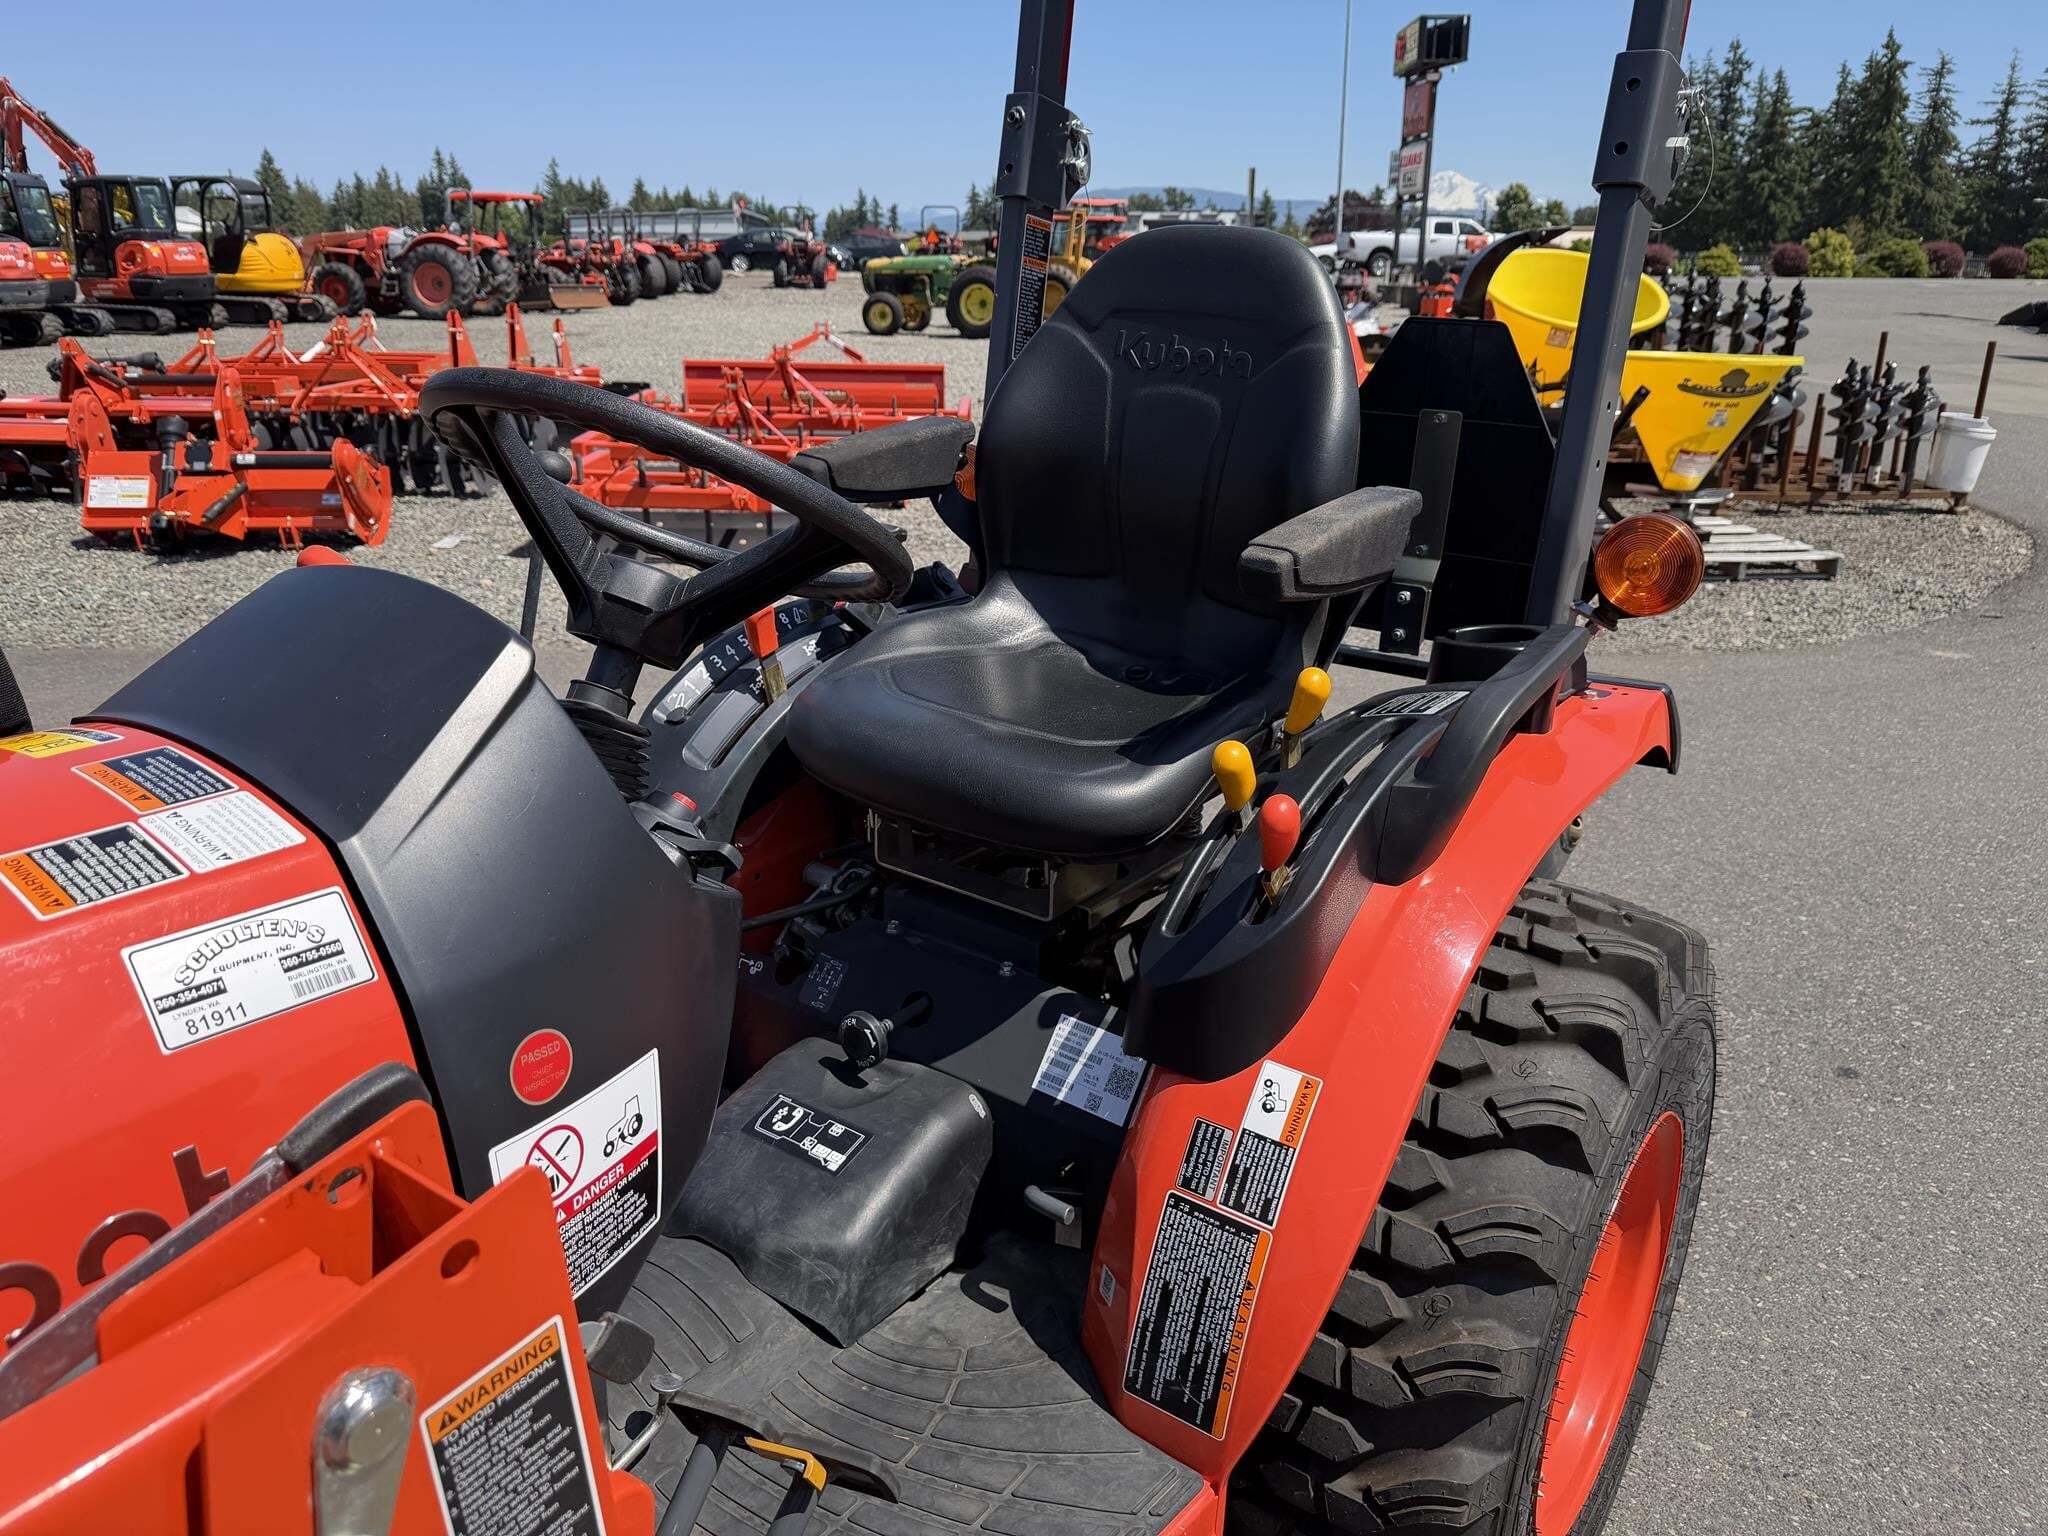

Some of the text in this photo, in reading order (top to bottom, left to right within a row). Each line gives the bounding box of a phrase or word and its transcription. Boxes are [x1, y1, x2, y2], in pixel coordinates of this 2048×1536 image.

[1117, 329, 1255, 379] Kubota
[778, 612, 789, 624] 8
[710, 655, 722, 667] 3
[725, 645, 736, 656] 4
[737, 634, 749, 646] 5
[174, 819, 221, 852] WARNING
[3, 857, 55, 901] WARNING
[176, 919, 326, 986] SCHOLTEN'S
[154, 979, 225, 1011] 360-354-4071
[183, 1001, 248, 1036] 81911
[520, 1040, 561, 1066] PASSED
[531, 1063, 554, 1080] CHIEF
[523, 1069, 566, 1094] INSPECTOR
[1194, 1122, 1206, 1146] stopped
[1214, 1128, 1221, 1138] Do
[1284, 1090, 1310, 1144] WARNING
[1210, 1137, 1218, 1148] not
[574, 1162, 623, 1209] DANGER
[1190, 1177, 1198, 1189] has
[1193, 1163, 1202, 1178] PTO
[1202, 1161, 1211, 1175] PTO
[1208, 1138, 1228, 1191] IMPORTANT
[559, 1158, 648, 1234] OSSIBLE INJURY OR DEATH
[560, 1191, 619, 1243] CHINE RUNAWAY.
[582, 1261, 595, 1277] PTO
[1222, 1232, 1257, 1354] TO AVOID PERSONAL INJURY OR DEATH:
[1220, 1296, 1252, 1394] WARNING
[458, 1335, 550, 1415] WARNING
[442, 1355, 554, 1447] TO AVOID PERSONAL
[450, 1433, 486, 1466] Observe
[487, 1412, 512, 1438] safety
[514, 1377, 558, 1417] precautions
[445, 1421, 486, 1458] INJURY
[454, 1419, 531, 1483] Operator's Manual.
[457, 1460, 490, 1491] Operate
[492, 1448, 506, 1464] the
[506, 1428, 532, 1452] loader
[532, 1412, 552, 1431] from
[462, 1441, 488, 1467] loader
[489, 1427, 506, 1445] and
[507, 1407, 532, 1432] tractor
[519, 1436, 545, 1461] others
[546, 1423, 561, 1440] and
[459, 1442, 526, 1500] tractor seat only.
[463, 1484, 498, 1516] livestock
[500, 1466, 521, 1489] away
[523, 1447, 543, 1468] when
[510, 1485, 533, 1507] which
[534, 1470, 552, 1490] may
[552, 1449, 576, 1474] cause
[467, 1509, 491, 1532] Avoid
[517, 1470, 539, 1492] loose
[479, 1488, 505, 1514] loader
[506, 1474, 522, 1491] and
[504, 1498, 529, 1523] loader
[517, 1465, 579, 1521] approved bucket
[541, 1500, 559, 1520] from
[520, 1504, 545, 1528] before
